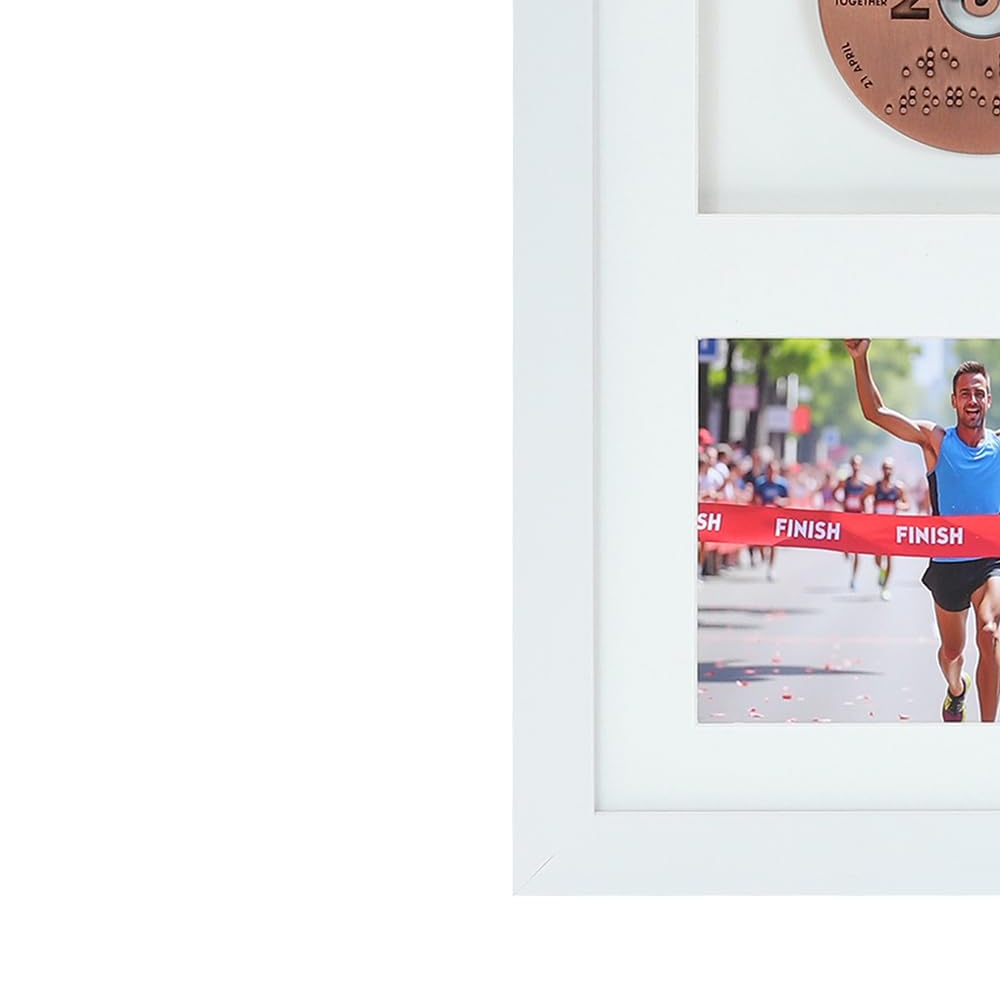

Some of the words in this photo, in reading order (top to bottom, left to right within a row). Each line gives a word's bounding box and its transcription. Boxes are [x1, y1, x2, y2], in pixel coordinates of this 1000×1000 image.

[841, 41, 863, 73] APRIL
[860, 75, 874, 89] 21
[774, 517, 842, 541] FINISH
[895, 525, 964, 545] FINISH
